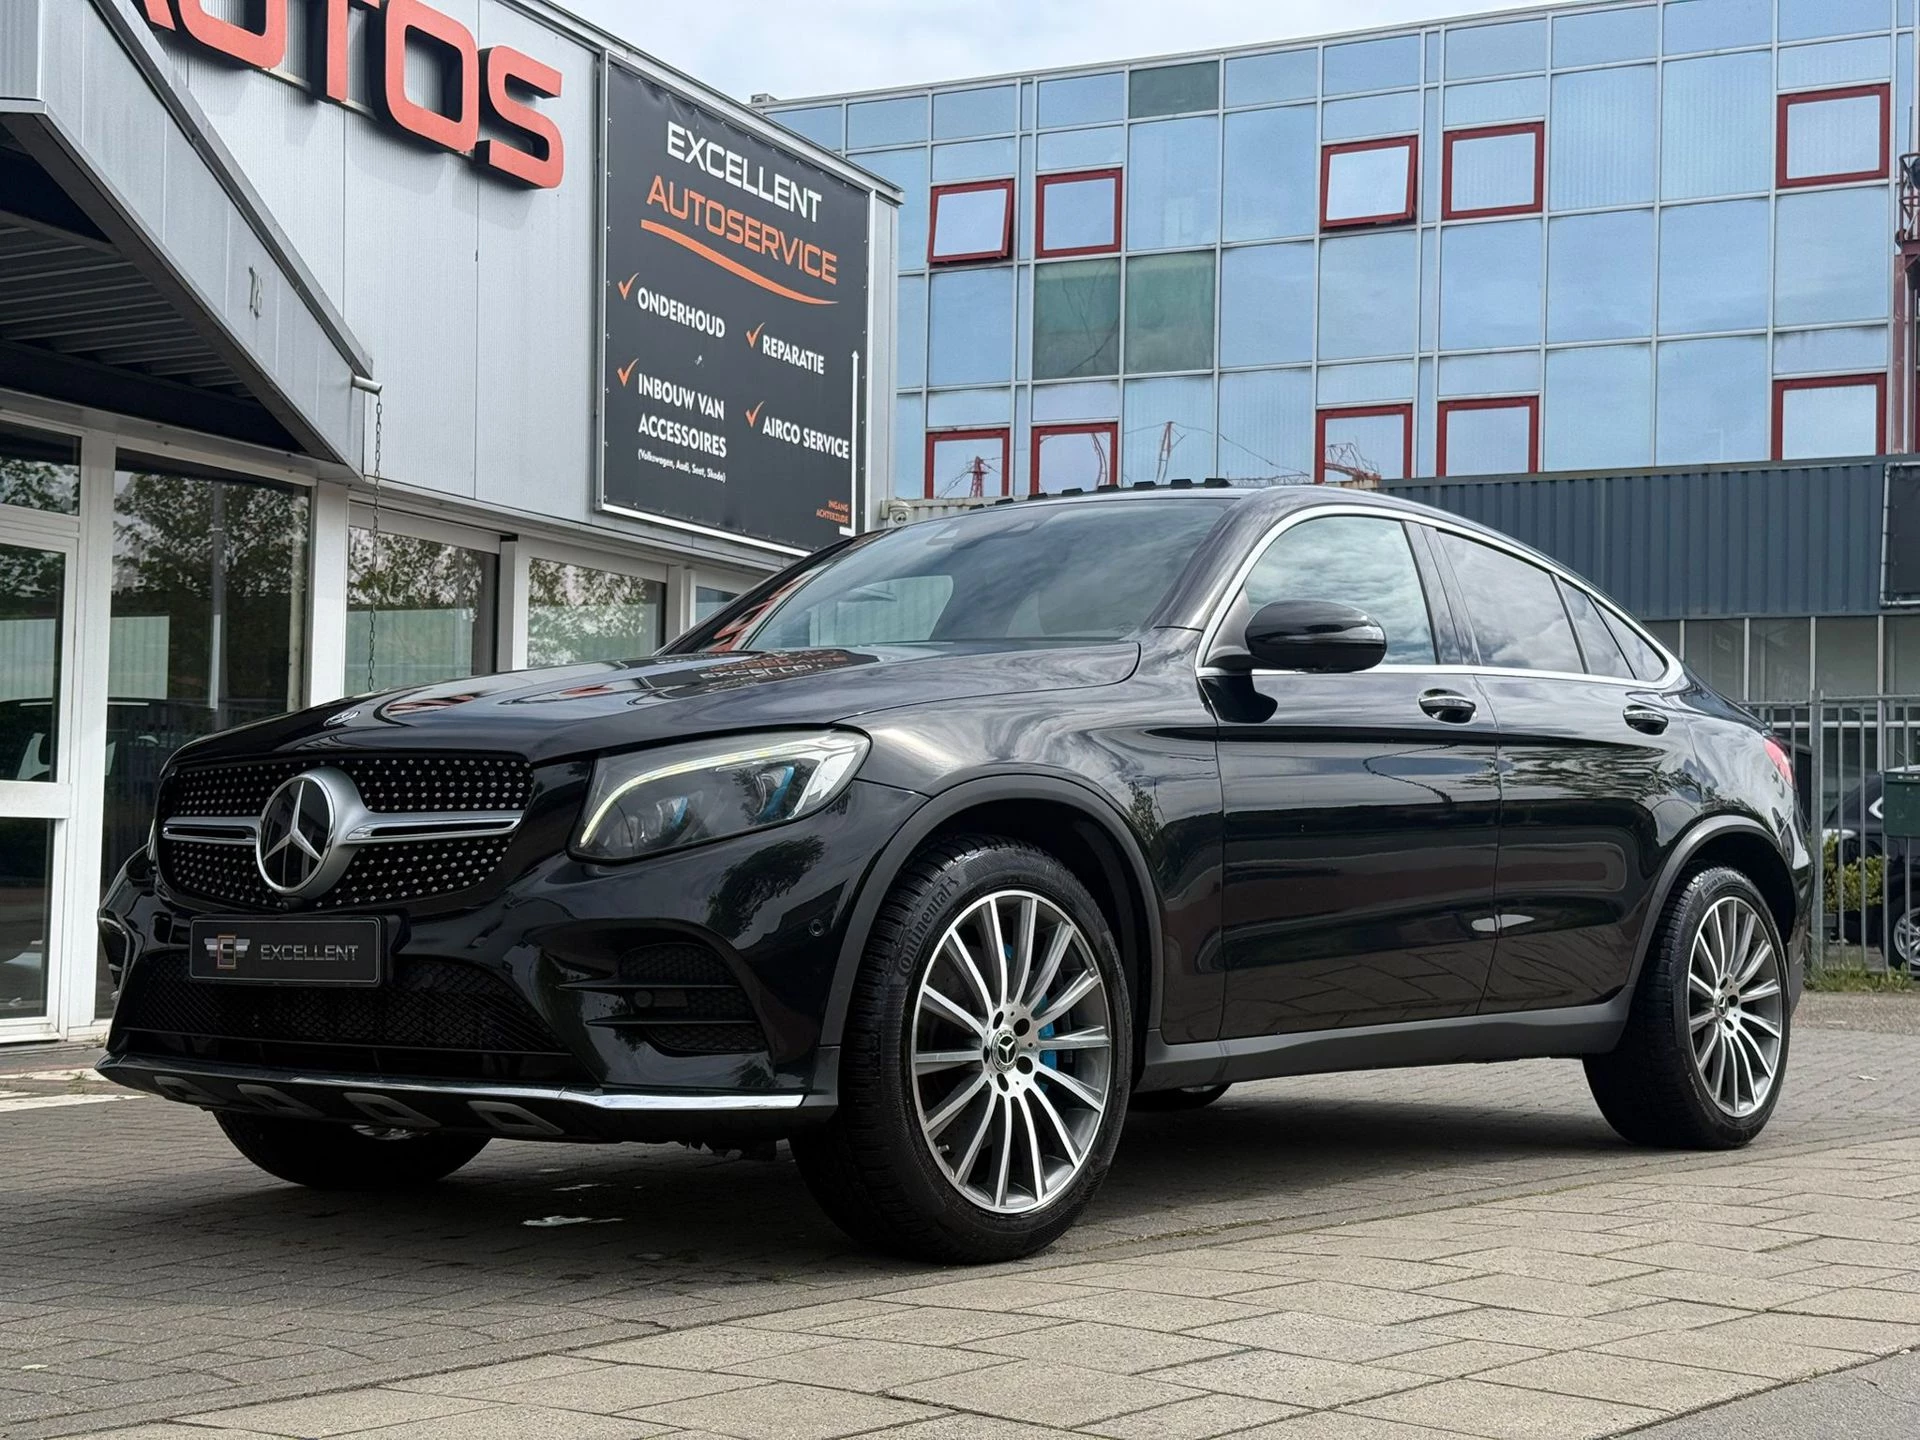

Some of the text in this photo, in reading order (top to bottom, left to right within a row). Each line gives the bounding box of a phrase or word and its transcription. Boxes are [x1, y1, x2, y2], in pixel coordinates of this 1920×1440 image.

[145, 0, 564, 189] TOS
[667, 120, 823, 223] EXCELLENT
[646, 175, 838, 285] AUTOSERVICE
[637, 287, 726, 338] ONDERHOUD
[762, 334, 825, 375] REPARATIE
[638, 372, 725, 421] INBOUW VAN
[638, 412, 727, 458] ACCESSOIRES
[762, 415, 850, 460] AIRCO SERVICE
[260, 944, 359, 961] EXCELLENT
[896, 882, 953, 977] Continental
